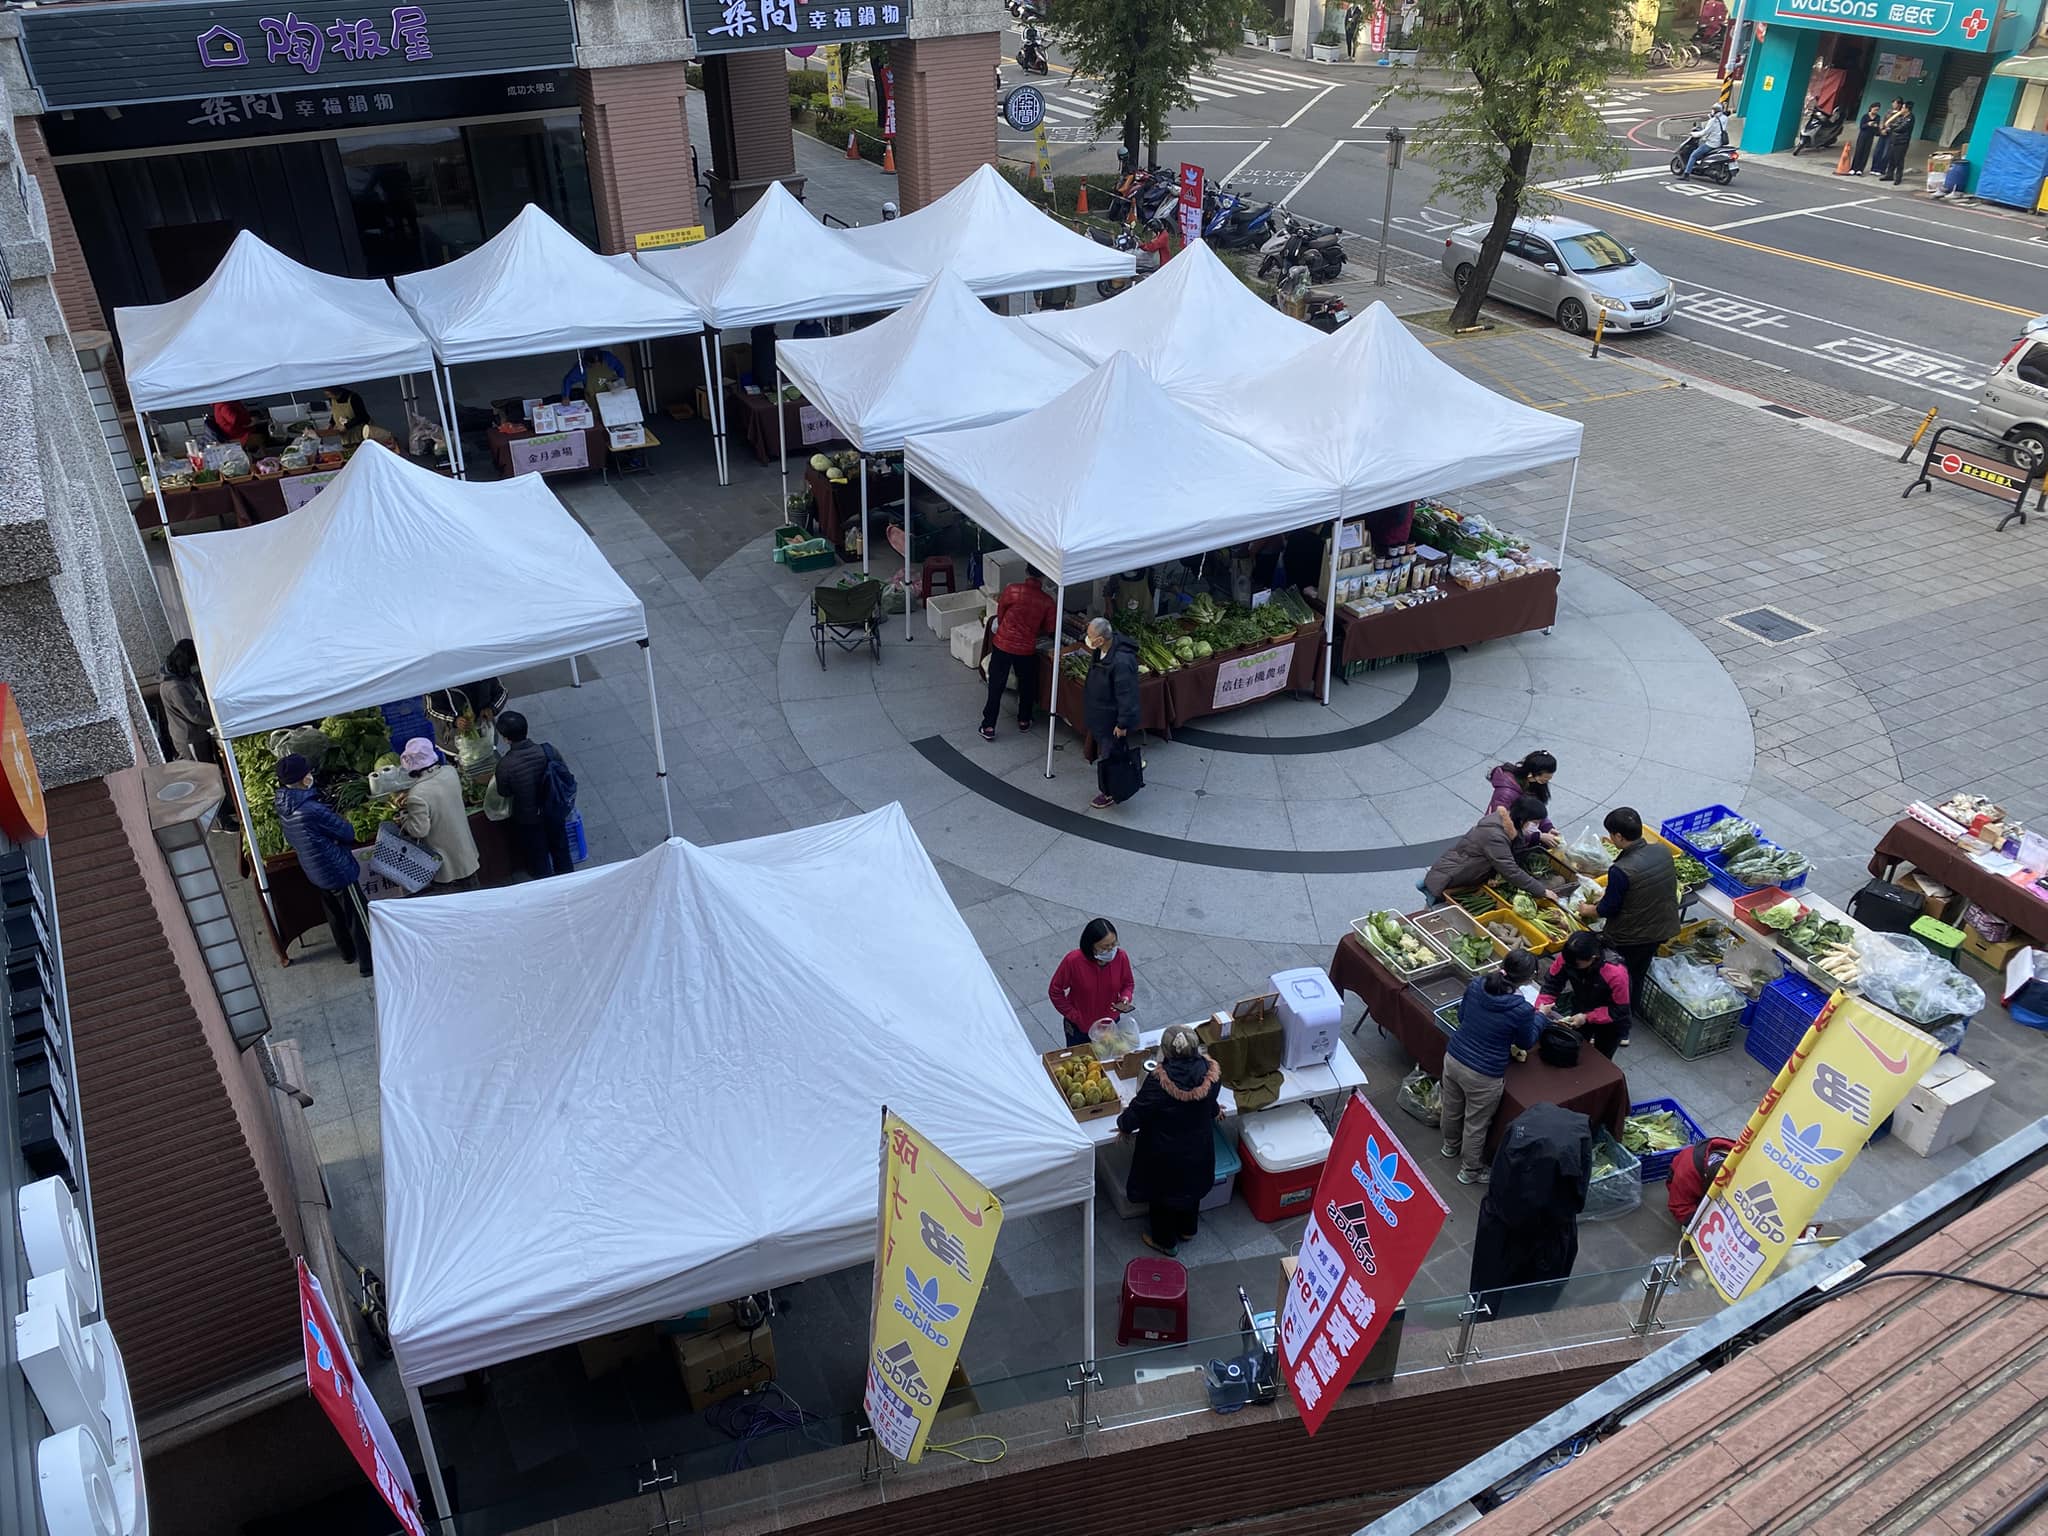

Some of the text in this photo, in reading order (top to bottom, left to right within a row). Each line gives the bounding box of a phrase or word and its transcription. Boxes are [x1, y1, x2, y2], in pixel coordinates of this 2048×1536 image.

[809, 5, 899, 30] 幸福鍋物
[1888, 5, 1936, 27] 屈臣氏
[259, 6, 433, 73] 陶板屋
[506, 82, 555, 96] 成功大學店
[295, 93, 395, 117] 幸福鍋物
[1222, 664, 1286, 692] 信佳有機農場
